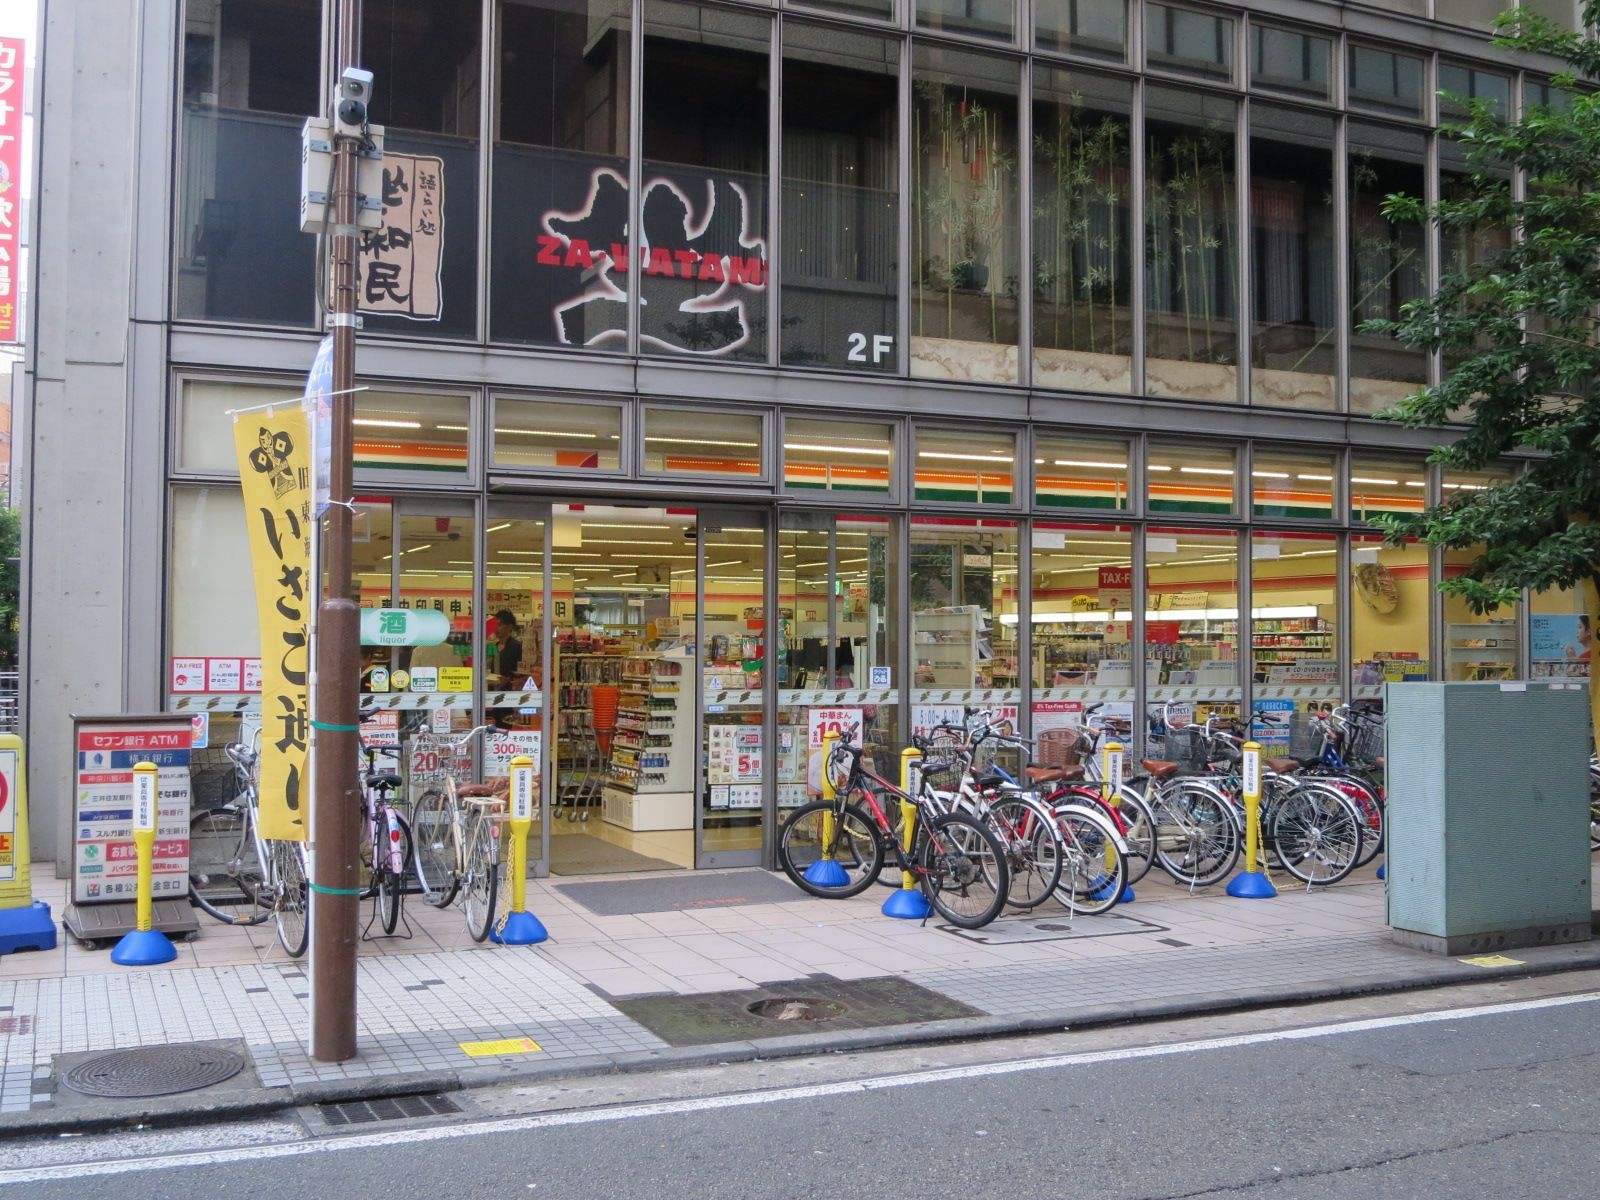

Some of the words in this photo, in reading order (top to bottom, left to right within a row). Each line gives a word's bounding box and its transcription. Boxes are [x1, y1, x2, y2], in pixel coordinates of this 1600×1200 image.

[417, 170, 437, 236] 語らい処
[847, 332, 894, 363] 2F
[1101, 572, 1131, 584] TAX-F
[379, 611, 407, 634] 酒
[380, 636, 407, 644] liquor
[819, 711, 852, 720] 中華まん
[94, 735, 145, 747] セブン銀行
[149, 734, 179, 745] ATM
[157, 809, 184, 817] 岡銀行
